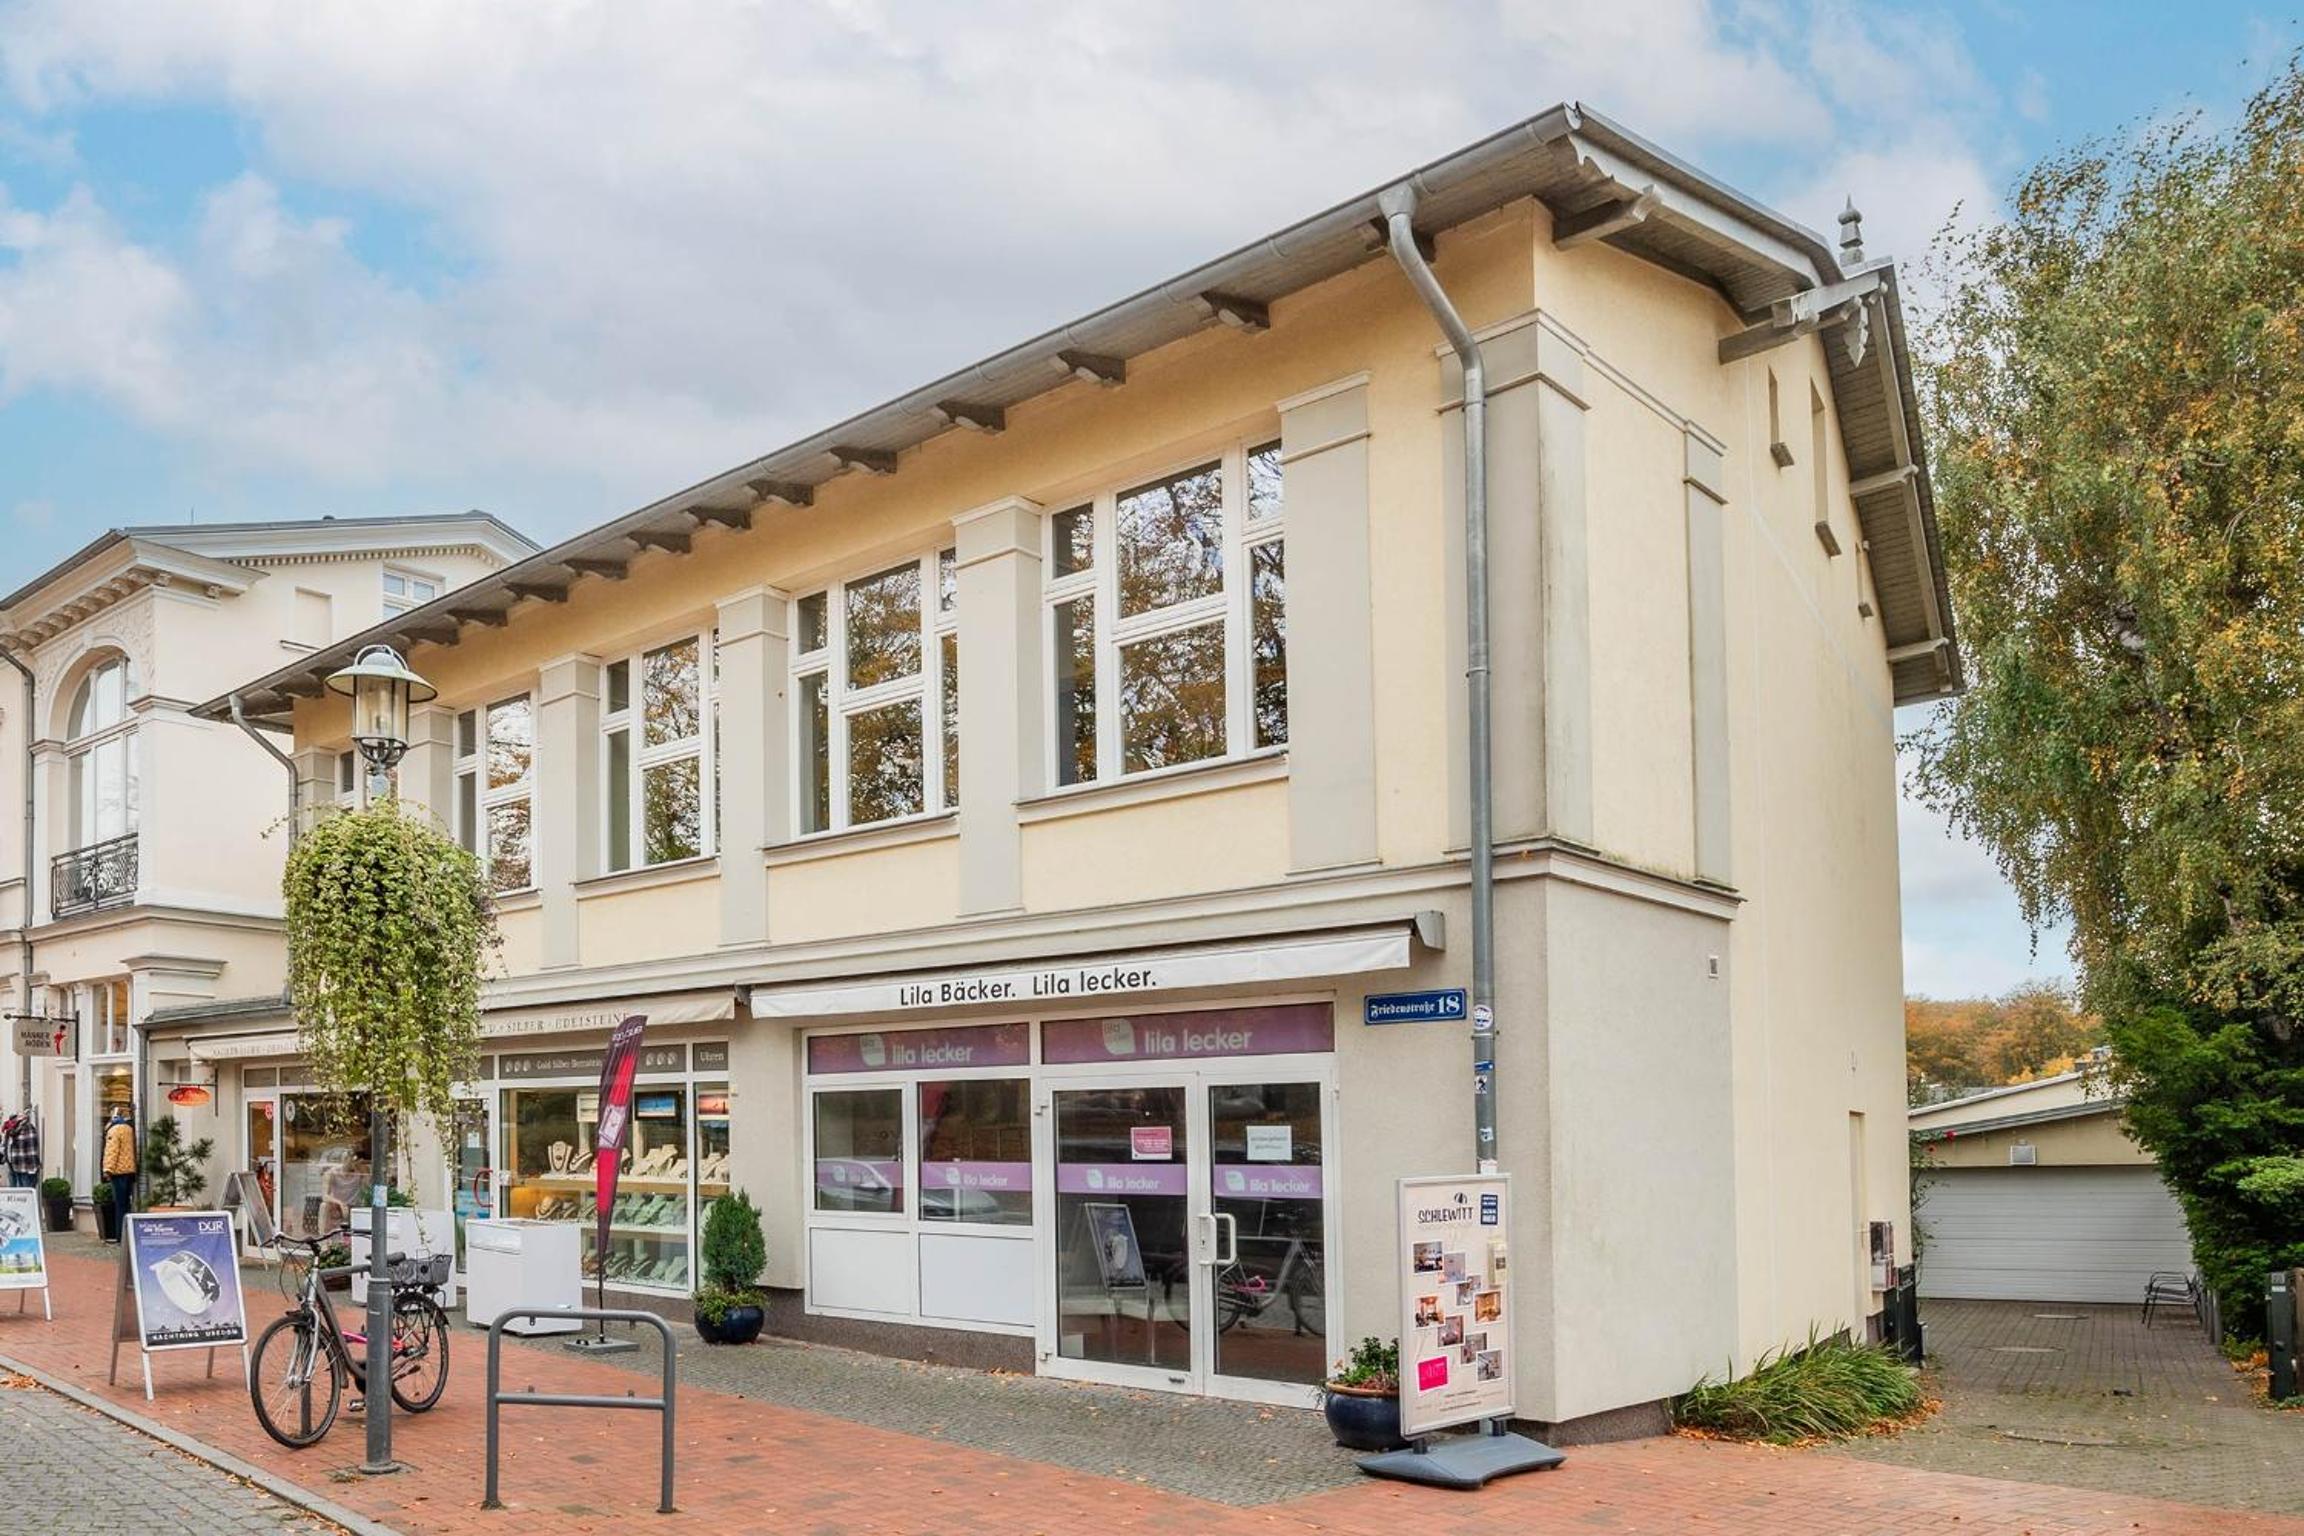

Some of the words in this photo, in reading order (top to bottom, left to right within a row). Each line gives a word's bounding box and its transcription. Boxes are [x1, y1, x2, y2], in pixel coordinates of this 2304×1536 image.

[900, 986, 932, 1006] Lila
[940, 980, 1016, 1002] Bäcker.
[1033, 975, 1070, 996] Lila
[1080, 967, 1157, 993] lecker.
[1438, 995, 1460, 1014] 18
[1144, 1030, 1175, 1055] lila
[1183, 1026, 1253, 1052] lecker
[892, 1044, 916, 1066] lila
[921, 1041, 973, 1064] lecker
[1418, 1206, 1474, 1224] SCHLEWITT
